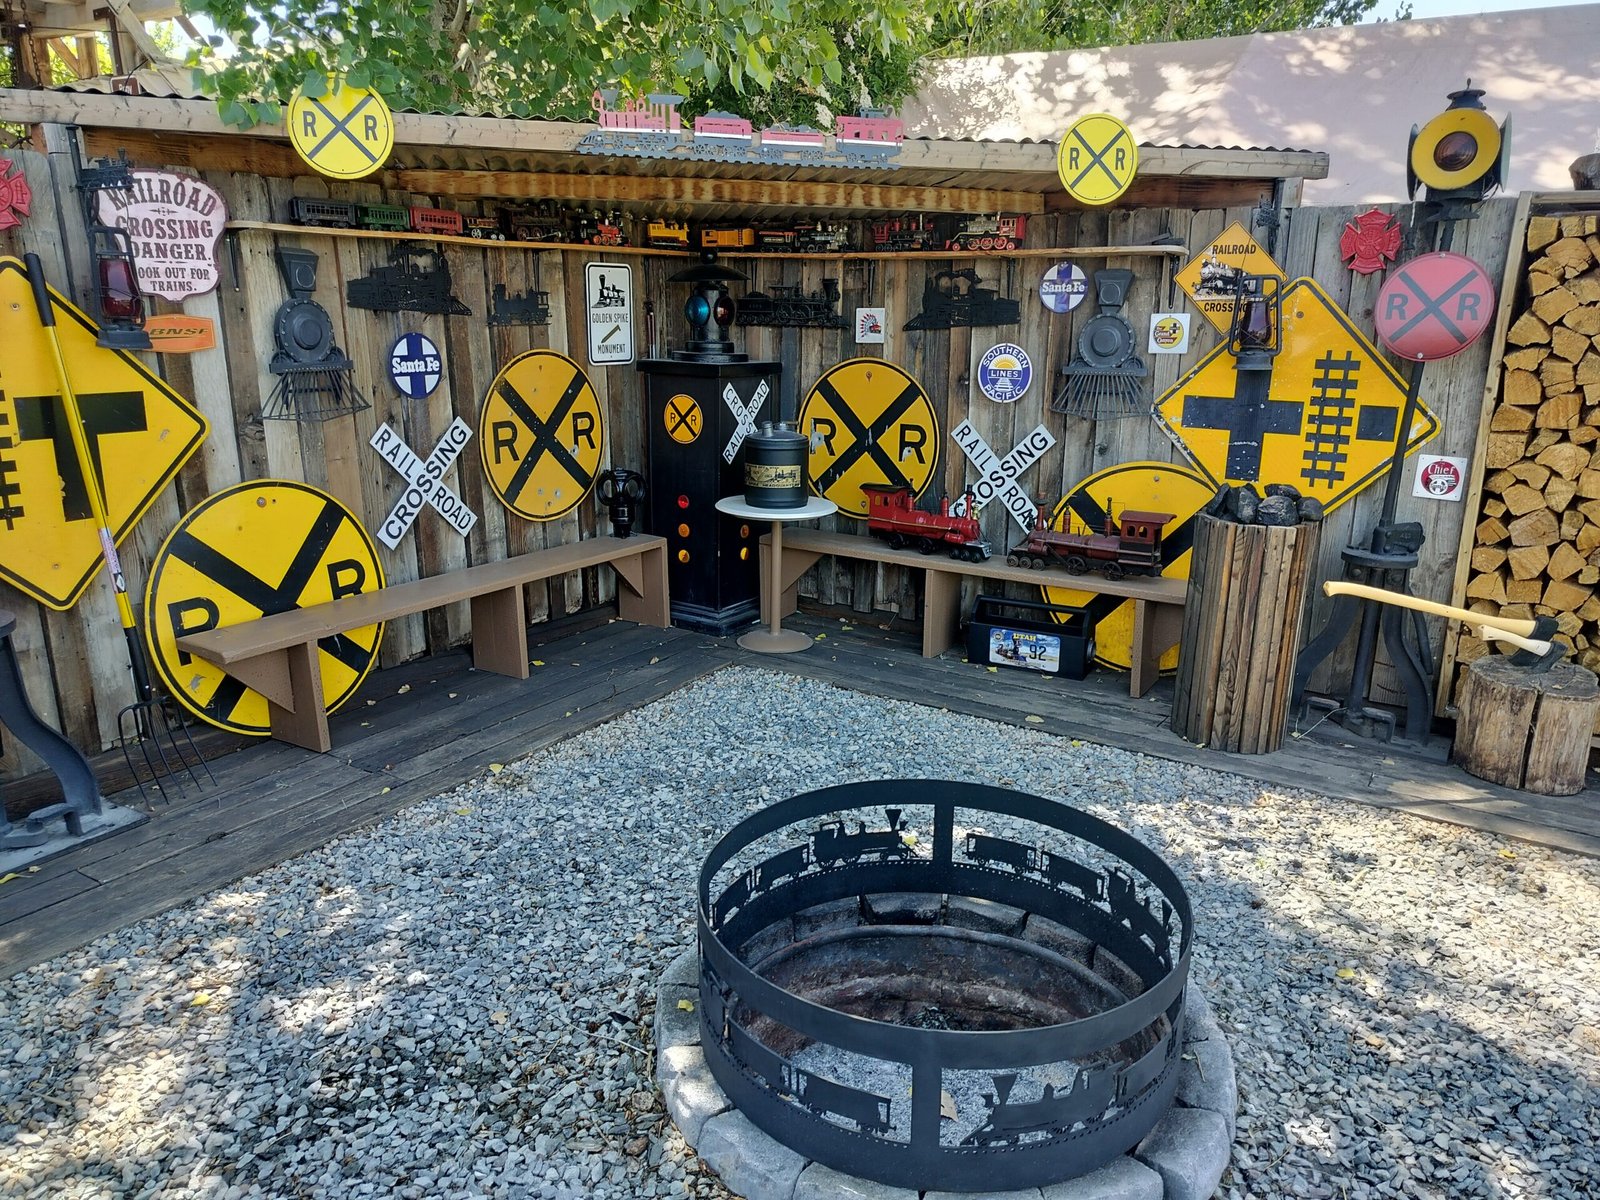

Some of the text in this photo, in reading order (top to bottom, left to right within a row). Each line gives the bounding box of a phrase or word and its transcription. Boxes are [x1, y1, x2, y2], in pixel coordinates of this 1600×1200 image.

[303, 110, 378, 140] R R
[1069, 147, 1126, 170] R R
[1212, 245, 1256, 255] RAILROAD
[138, 266, 210, 280] OOK OUT FOR
[150, 281, 197, 292] TRAINS.
[1042, 280, 1085, 292] Santa Fe
[1204, 302, 1247, 312] CROSS
[1385, 293, 1481, 320] R R
[592, 313, 628, 324] GOLDEN SPIKE
[150, 328, 208, 336] BNSF
[598, 344, 626, 354] MONUMENT
[983, 346, 1028, 368] SOUTHERN
[392, 356, 440, 374] Santa Fe
[984, 384, 1022, 400] PACIFIC
[670, 412, 696, 426] R R
[726, 388, 757, 434] CROSS
[492, 411, 596, 464] R R
[810, 418, 927, 464] R R
[1428, 463, 1456, 474] Chief
[385, 425, 468, 540] CROSSING
[1002, 486, 1034, 524] ROA
[1012, 632, 1037, 642] UTAH
[1029, 644, 1046, 661] 92
